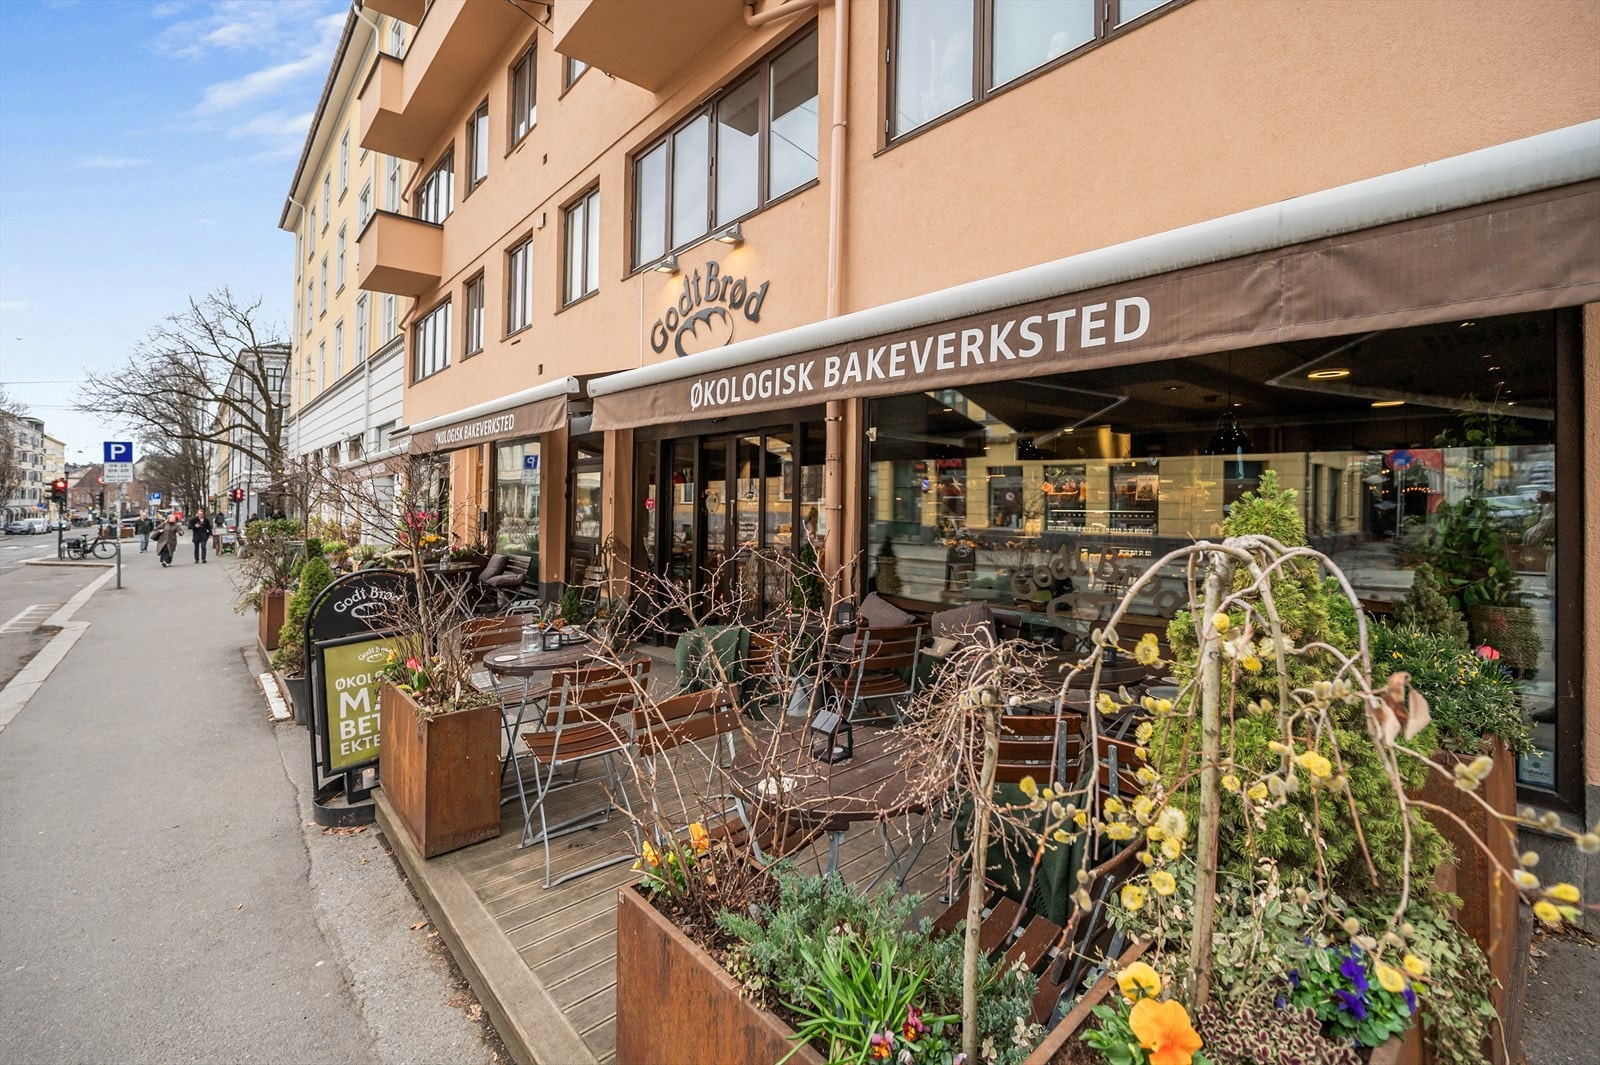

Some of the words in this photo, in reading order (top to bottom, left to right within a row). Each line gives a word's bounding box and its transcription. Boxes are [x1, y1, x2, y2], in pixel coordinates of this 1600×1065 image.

[651, 267, 702, 354] Godt
[704, 260, 770, 324] Brød
[690, 360, 814, 412] ØKOLOGISK
[824, 296, 1152, 388] BAKEVERKSTED
[464, 413, 515, 440] BAKEVERKSTED
[110, 443, 127, 460] P
[1010, 543, 1084, 600] Godt
[333, 587, 366, 613] Godt
